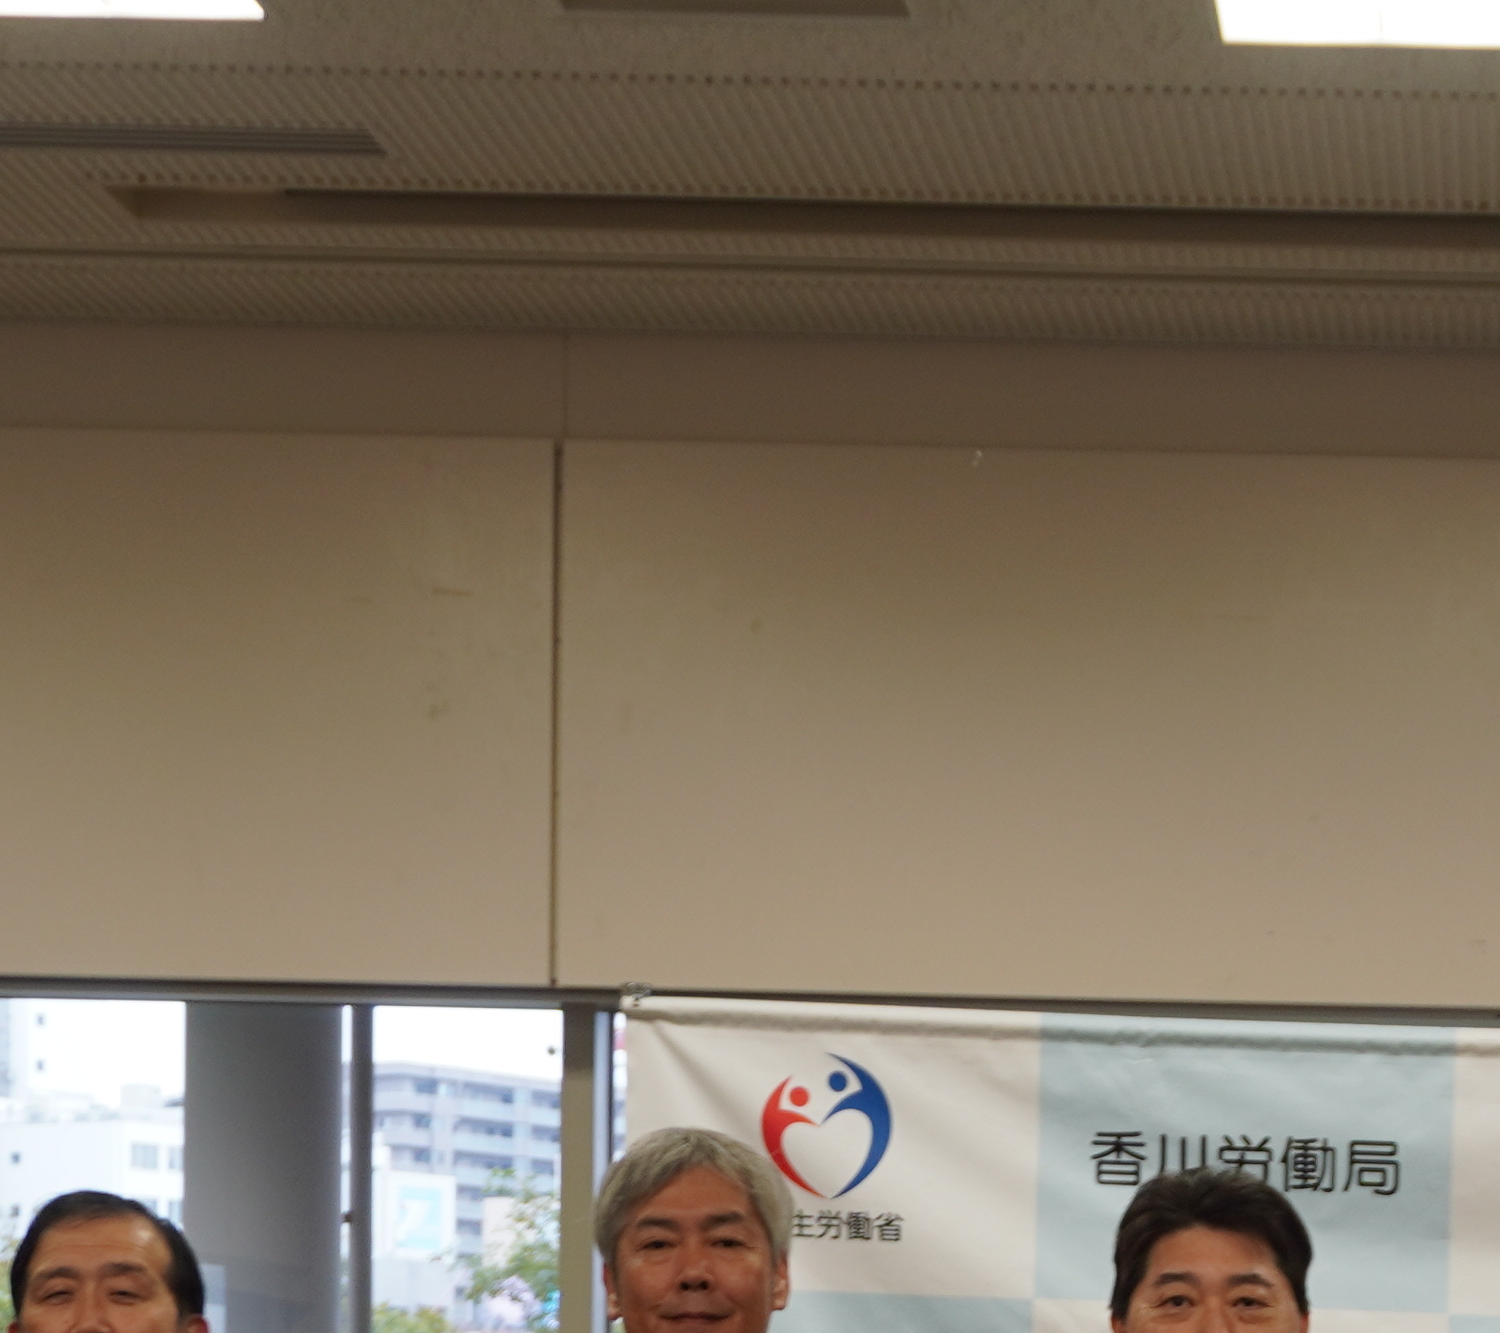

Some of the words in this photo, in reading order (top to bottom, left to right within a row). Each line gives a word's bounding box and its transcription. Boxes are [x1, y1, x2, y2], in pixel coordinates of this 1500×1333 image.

[1089, 1129, 1401, 1196] 香川労働局
